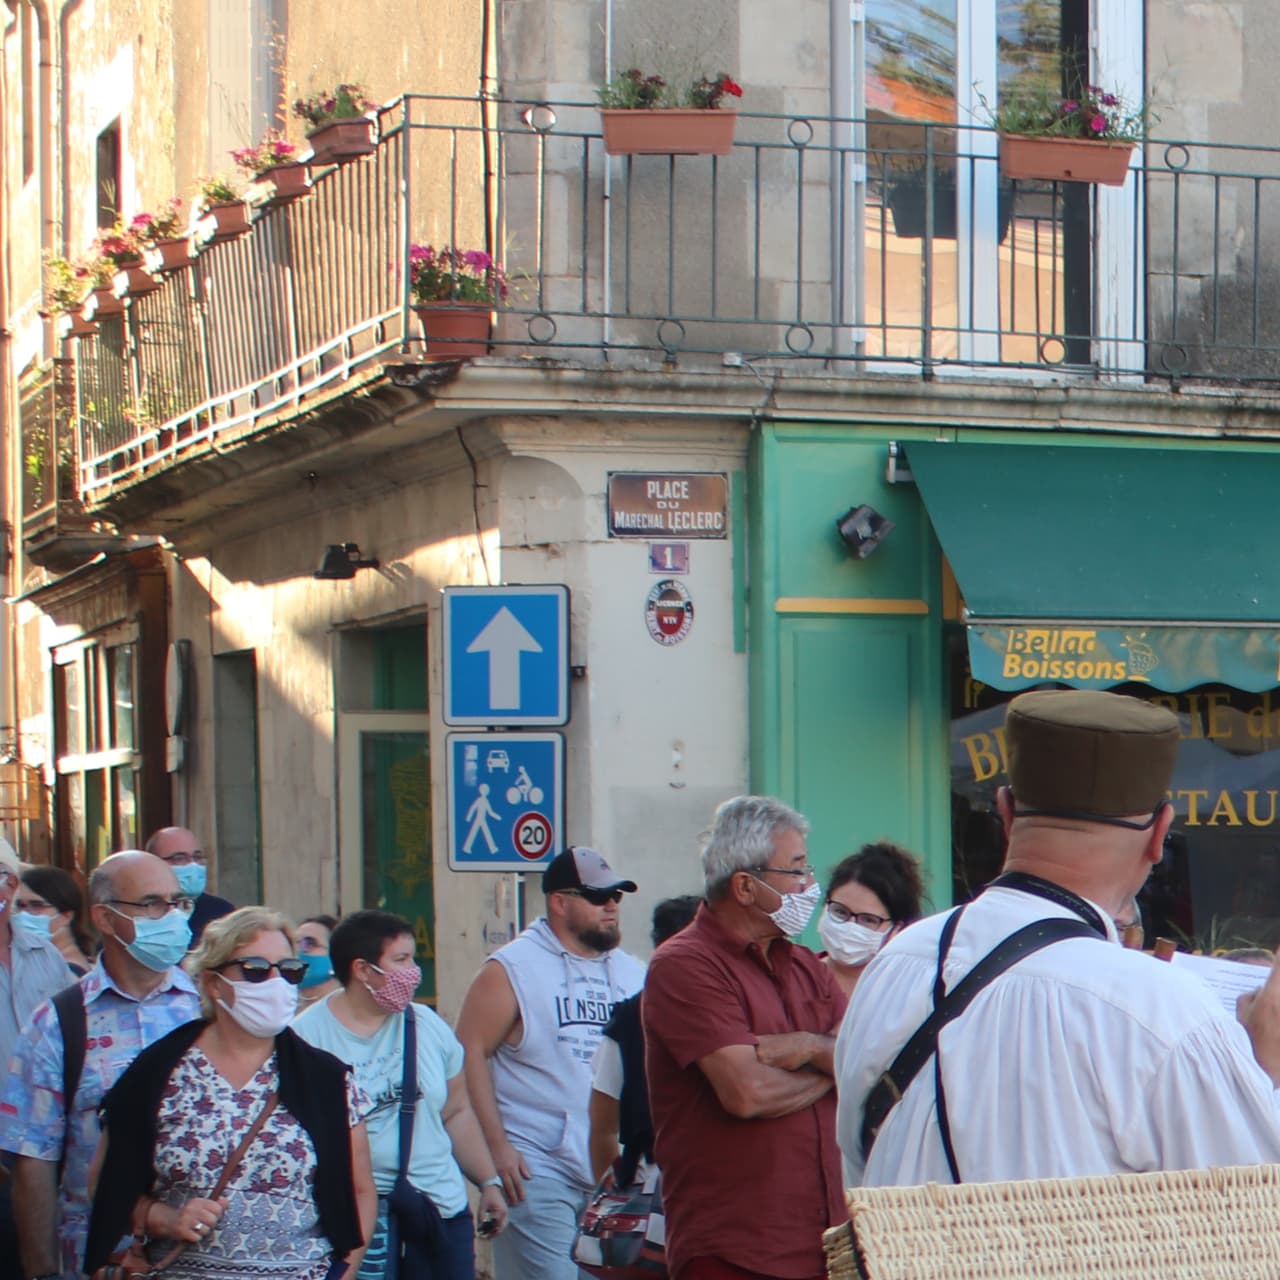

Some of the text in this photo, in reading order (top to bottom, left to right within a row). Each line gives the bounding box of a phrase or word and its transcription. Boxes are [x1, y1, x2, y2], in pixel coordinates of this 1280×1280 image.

[647, 480, 689, 499] PLACE
[656, 501, 680, 509] DU
[668, 511, 723, 529] LECLERC
[663, 547, 673, 568] 1
[1007, 629, 1097, 655] Bellac
[1002, 652, 1127, 681] Boissons
[522, 826, 545, 845] 20
